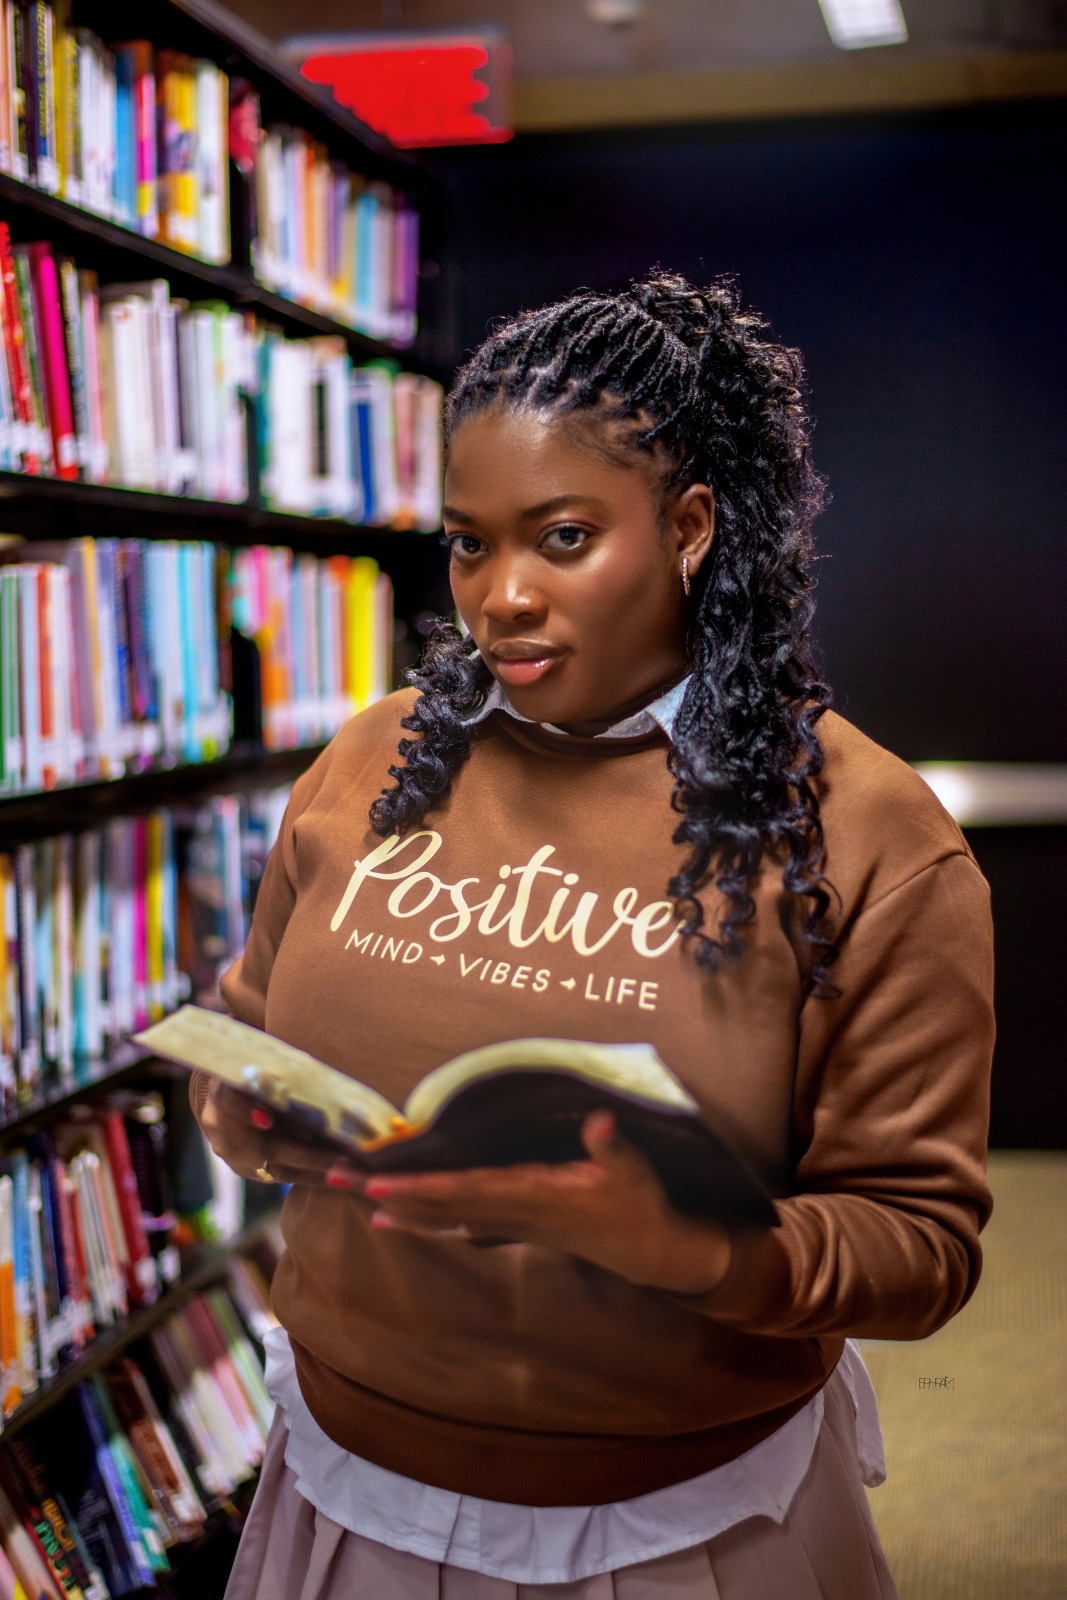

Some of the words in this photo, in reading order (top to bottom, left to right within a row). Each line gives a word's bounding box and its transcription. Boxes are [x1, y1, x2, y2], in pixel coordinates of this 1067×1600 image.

[330, 830, 687, 958] Positive
[344, 929, 424, 964] MIND
[459, 953, 551, 992] VIBES
[584, 973, 660, 1011] LIFE
